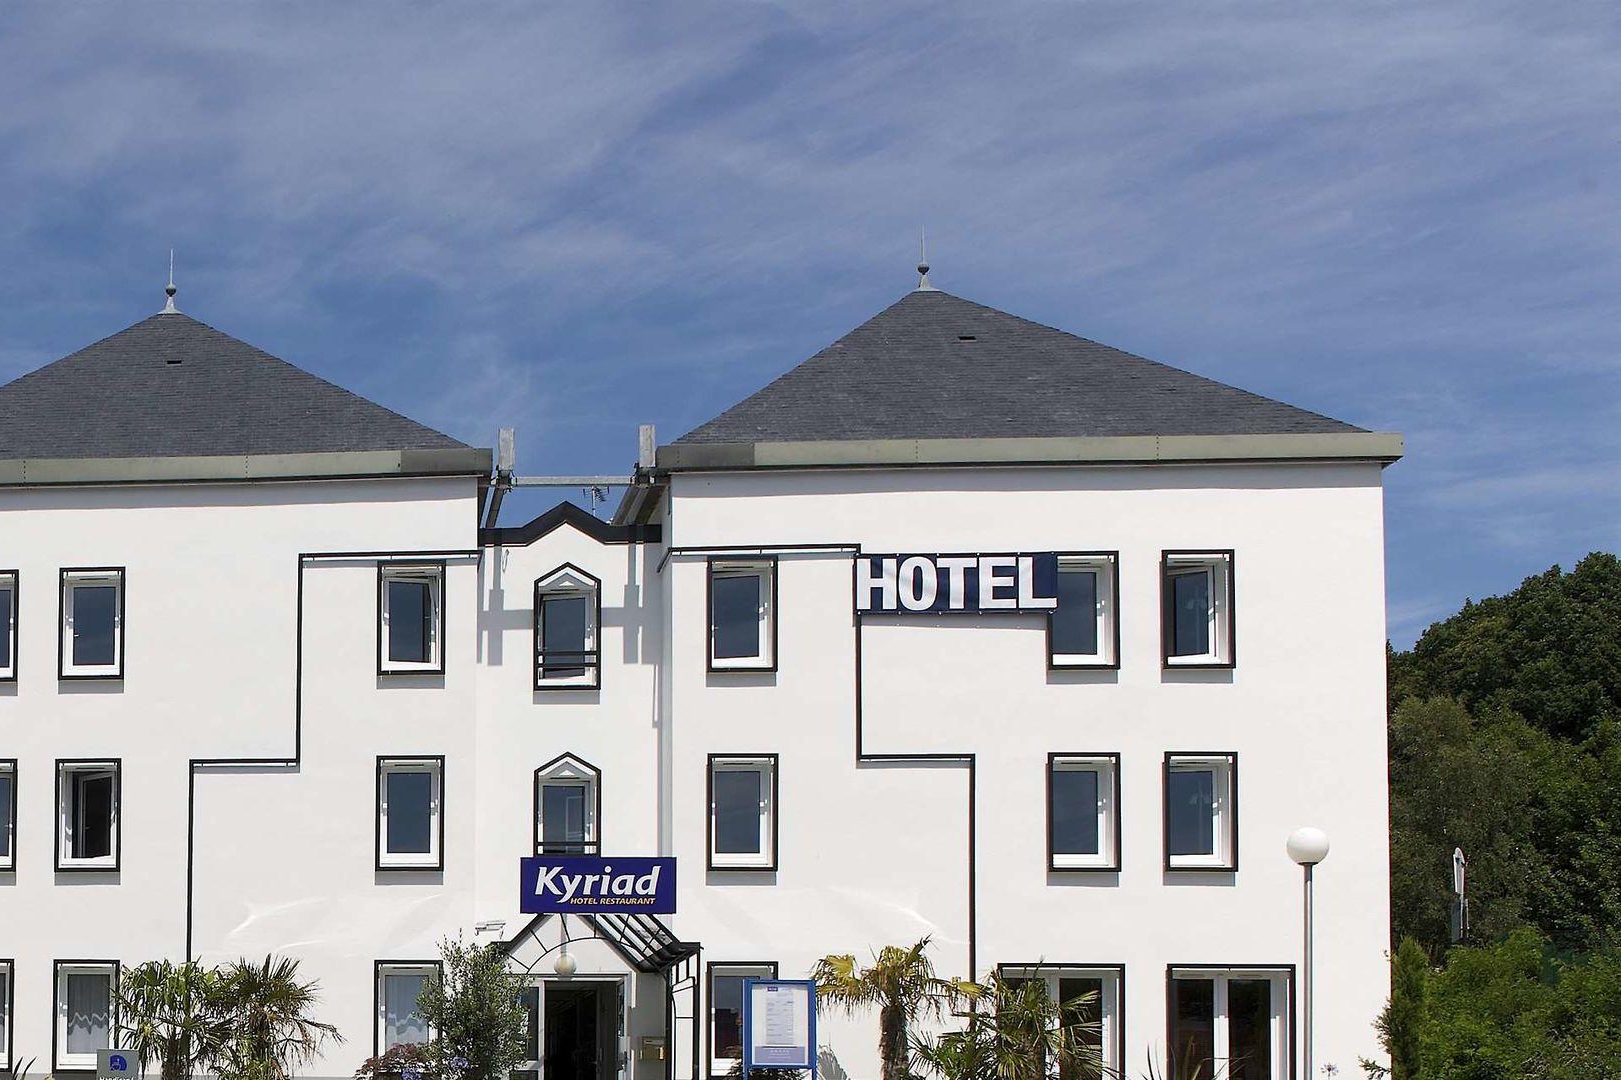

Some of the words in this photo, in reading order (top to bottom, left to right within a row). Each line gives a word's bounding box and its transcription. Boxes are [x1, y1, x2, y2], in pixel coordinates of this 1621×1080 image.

[856, 556, 1058, 611] HOTEL
[534, 865, 662, 904] Kyriad
[570, 897, 598, 905] HOTEL
[599, 897, 656, 905] RESTAURANT
